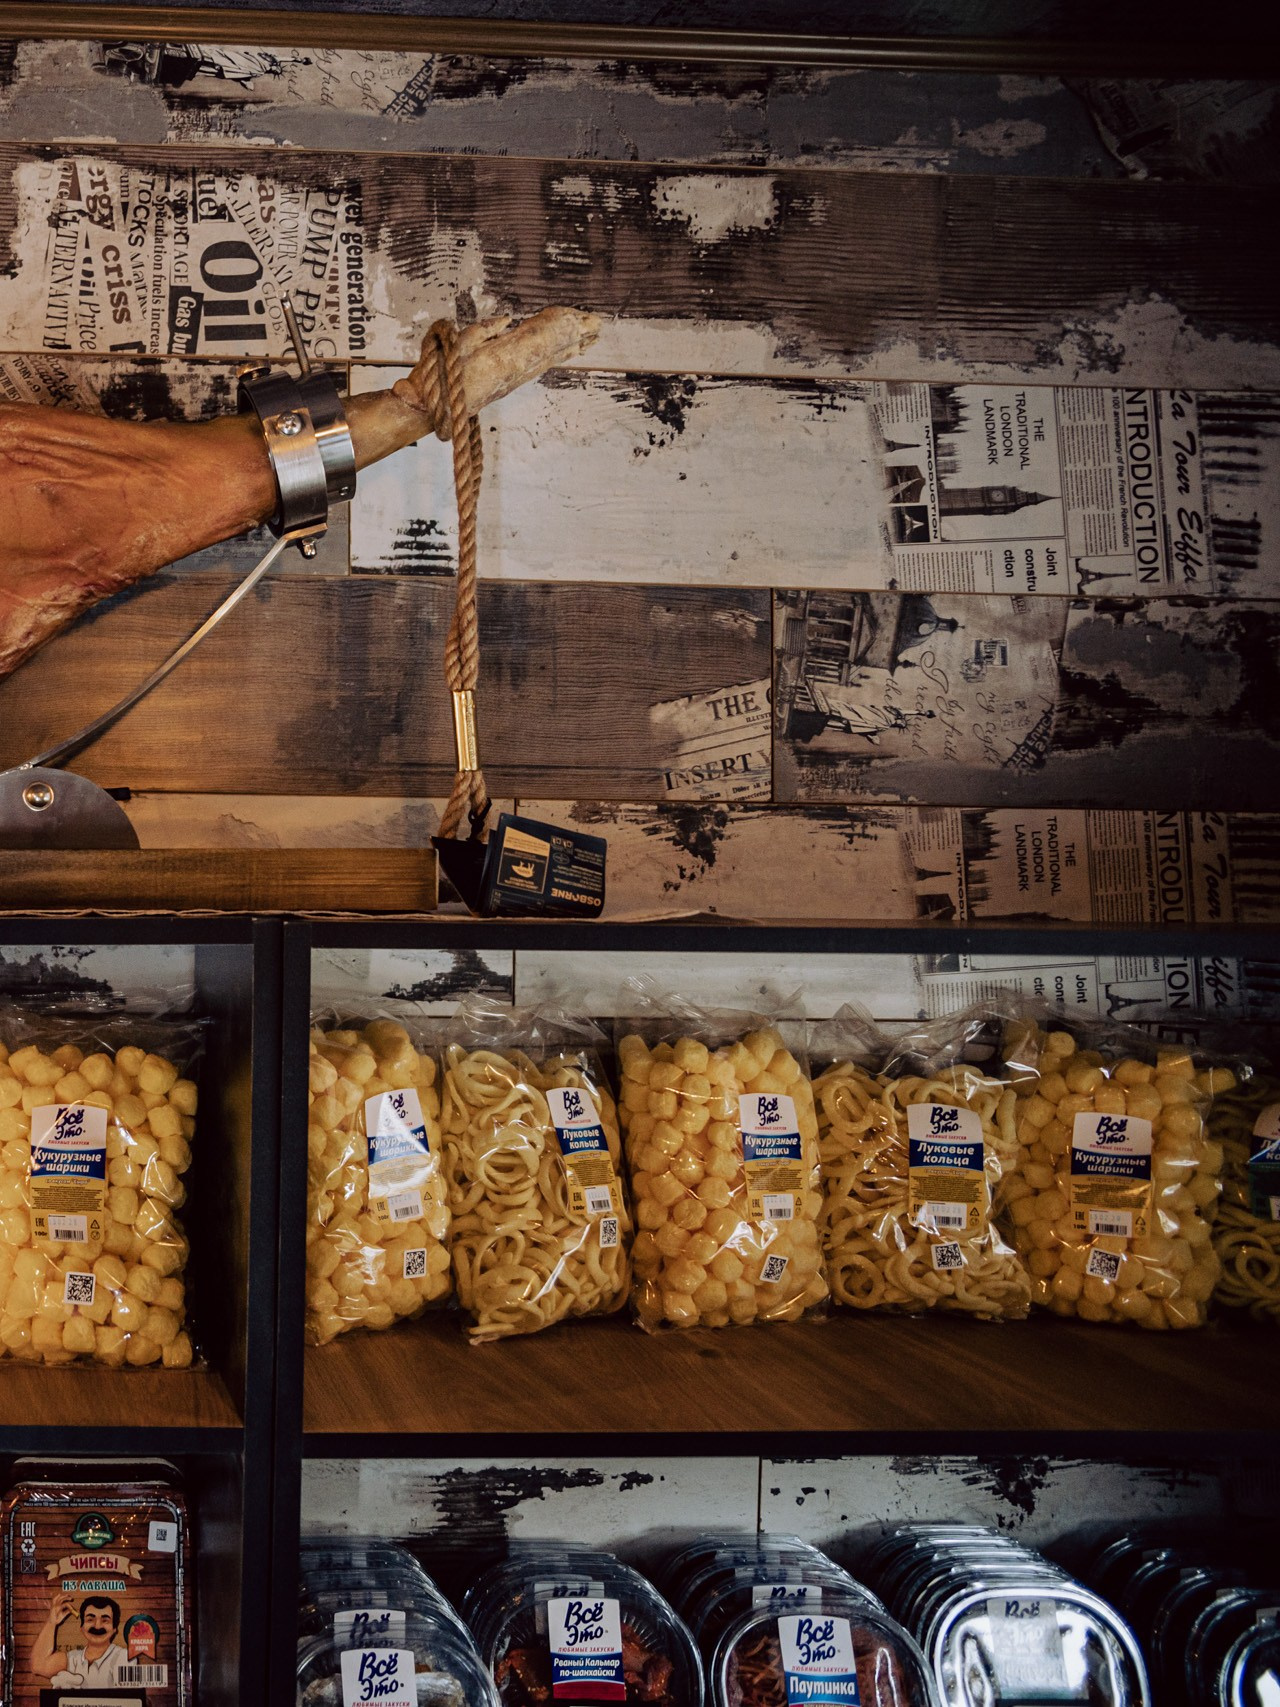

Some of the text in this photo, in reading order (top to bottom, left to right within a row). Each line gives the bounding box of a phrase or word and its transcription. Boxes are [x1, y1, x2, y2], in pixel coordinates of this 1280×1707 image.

[153, 194, 168, 275] Speculation
[278, 211, 300, 260] POWER
[102, 245, 133, 324] criss
[152, 275, 167, 306] fuels
[200, 240, 267, 341] Oil
[340, 232, 370, 351] generation
[79, 299, 101, 350] Price
[176, 296, 197, 328] Gas
[1112, 399, 1120, 409] 100
[983, 399, 998, 465] LANDMARK
[1000, 405, 1014, 457] LONDON
[1015, 391, 1030, 470] TRADITIONAL
[1033, 418, 1044, 442] THE
[1113, 411, 1123, 456] anniversary
[1172, 431, 1197, 494] Tour
[925, 425, 938, 539] INTRODUCTION
[1119, 479, 1127, 507] French
[1121, 508, 1130, 548] Revolution
[1004, 549, 1014, 578] ction
[1025, 548, 1036, 592] constru
[1046, 547, 1058, 576] Joint
[706, 691, 762, 720] THE
[664, 753, 752, 790] INSERT
[1014, 824, 1029, 891] LANDMARK
[1031, 830, 1045, 883] LONDON
[1046, 816, 1061, 896] TRADITIONAL
[1064, 842, 1076, 867] THE
[1203, 853, 1227, 919] Tour
[1075, 974, 1088, 1004] Joint
[563, 1129, 600, 1140] Луковые
[569, 1140, 600, 1150] кольца
[745, 1135, 798, 1148] Кукурузные
[917, 1142, 975, 1155] Луковые
[34, 1149, 102, 1165] Кукурузные
[755, 1147, 789, 1158] шарики
[923, 1154, 969, 1166] кольца
[1075, 1151, 1147, 1167] Кукурузные
[46, 1162, 90, 1174] шарики
[1087, 1165, 1134, 1175] шарики
[70, 1557, 118, 1570] ЧИПСЫ
[63, 1580, 127, 1591] ИЗ ЛАВАША
[553, 1657, 620, 1669] Рваный Кальмар
[560, 1667, 616, 1677] по-шанхайски
[790, 1675, 855, 1699] Паутинка
